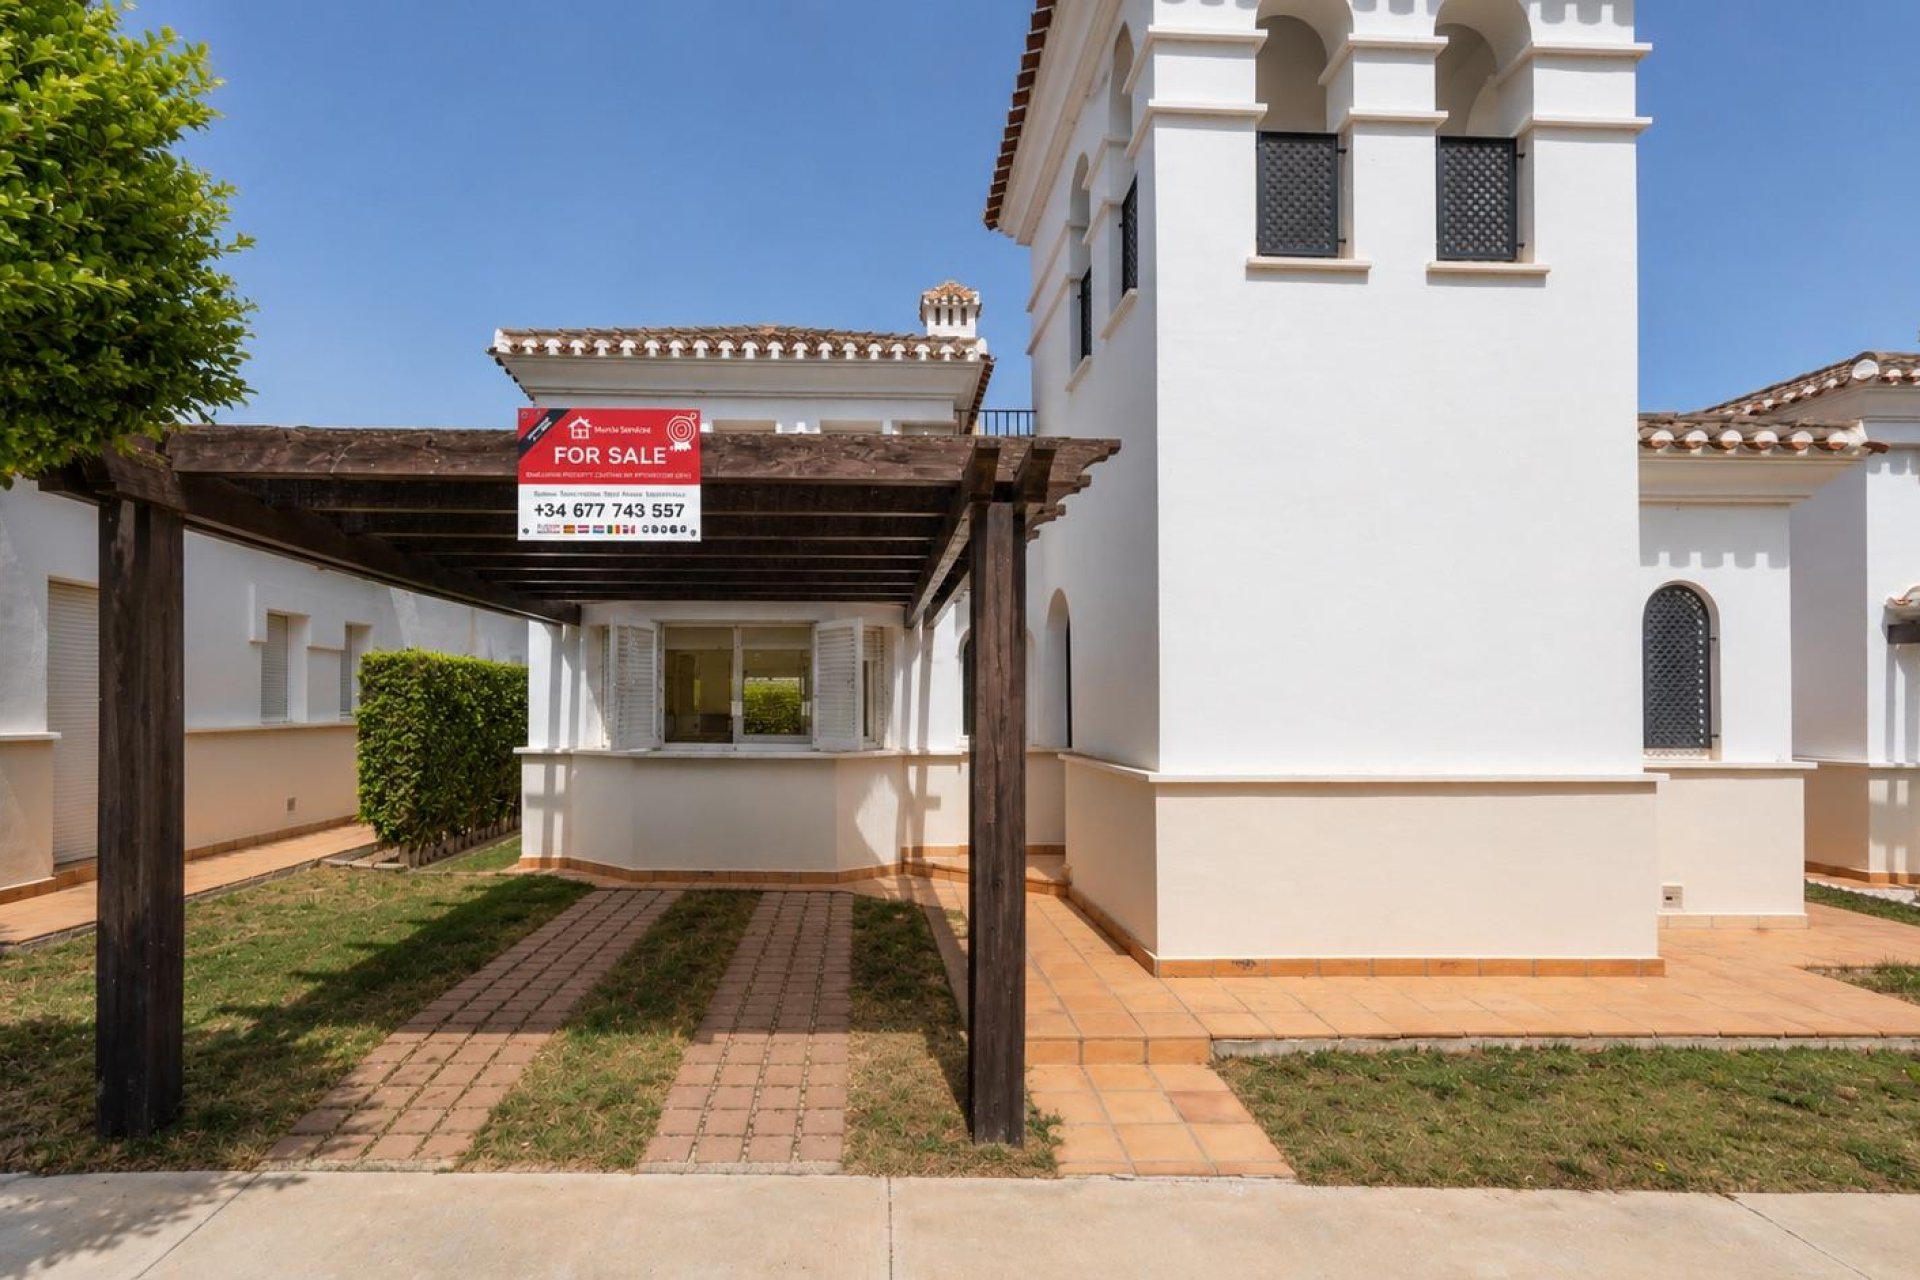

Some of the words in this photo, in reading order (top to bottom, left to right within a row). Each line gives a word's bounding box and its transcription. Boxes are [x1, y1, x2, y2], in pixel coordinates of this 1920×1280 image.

[554, 447, 600, 465] FOR
[608, 447, 667, 465] SALE
[534, 503, 566, 518] +34
[573, 503, 605, 518] 677
[612, 503, 645, 518] 743
[652, 503, 685, 518] 557
